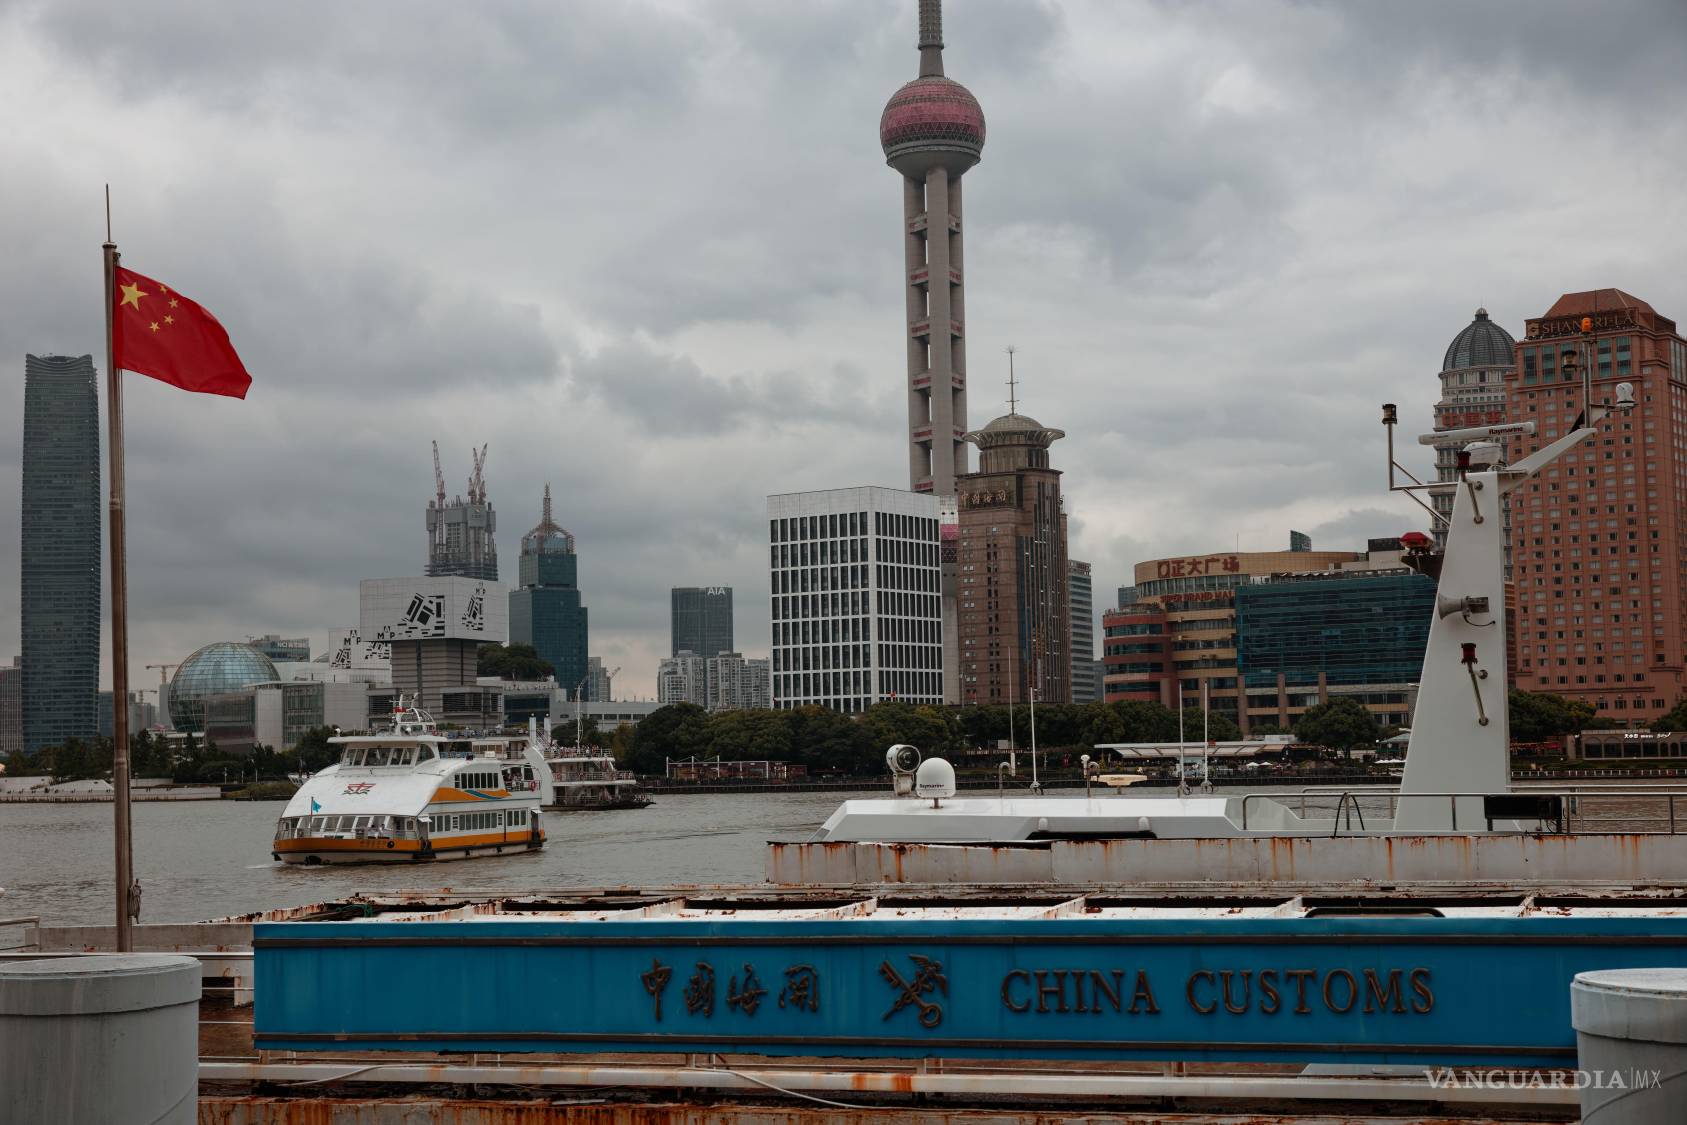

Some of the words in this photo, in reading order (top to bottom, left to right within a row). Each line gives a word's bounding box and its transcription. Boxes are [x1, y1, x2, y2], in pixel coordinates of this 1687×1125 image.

[1542, 311, 1634, 334] SHANRI-LA
[1489, 426, 1523, 436] Raymarine
[1171, 556, 1240, 577] 正大广场
[707, 587, 726, 596] AIA
[1001, 968, 1160, 1014] CHINA
[1186, 967, 1435, 1015] CUSTOMS
